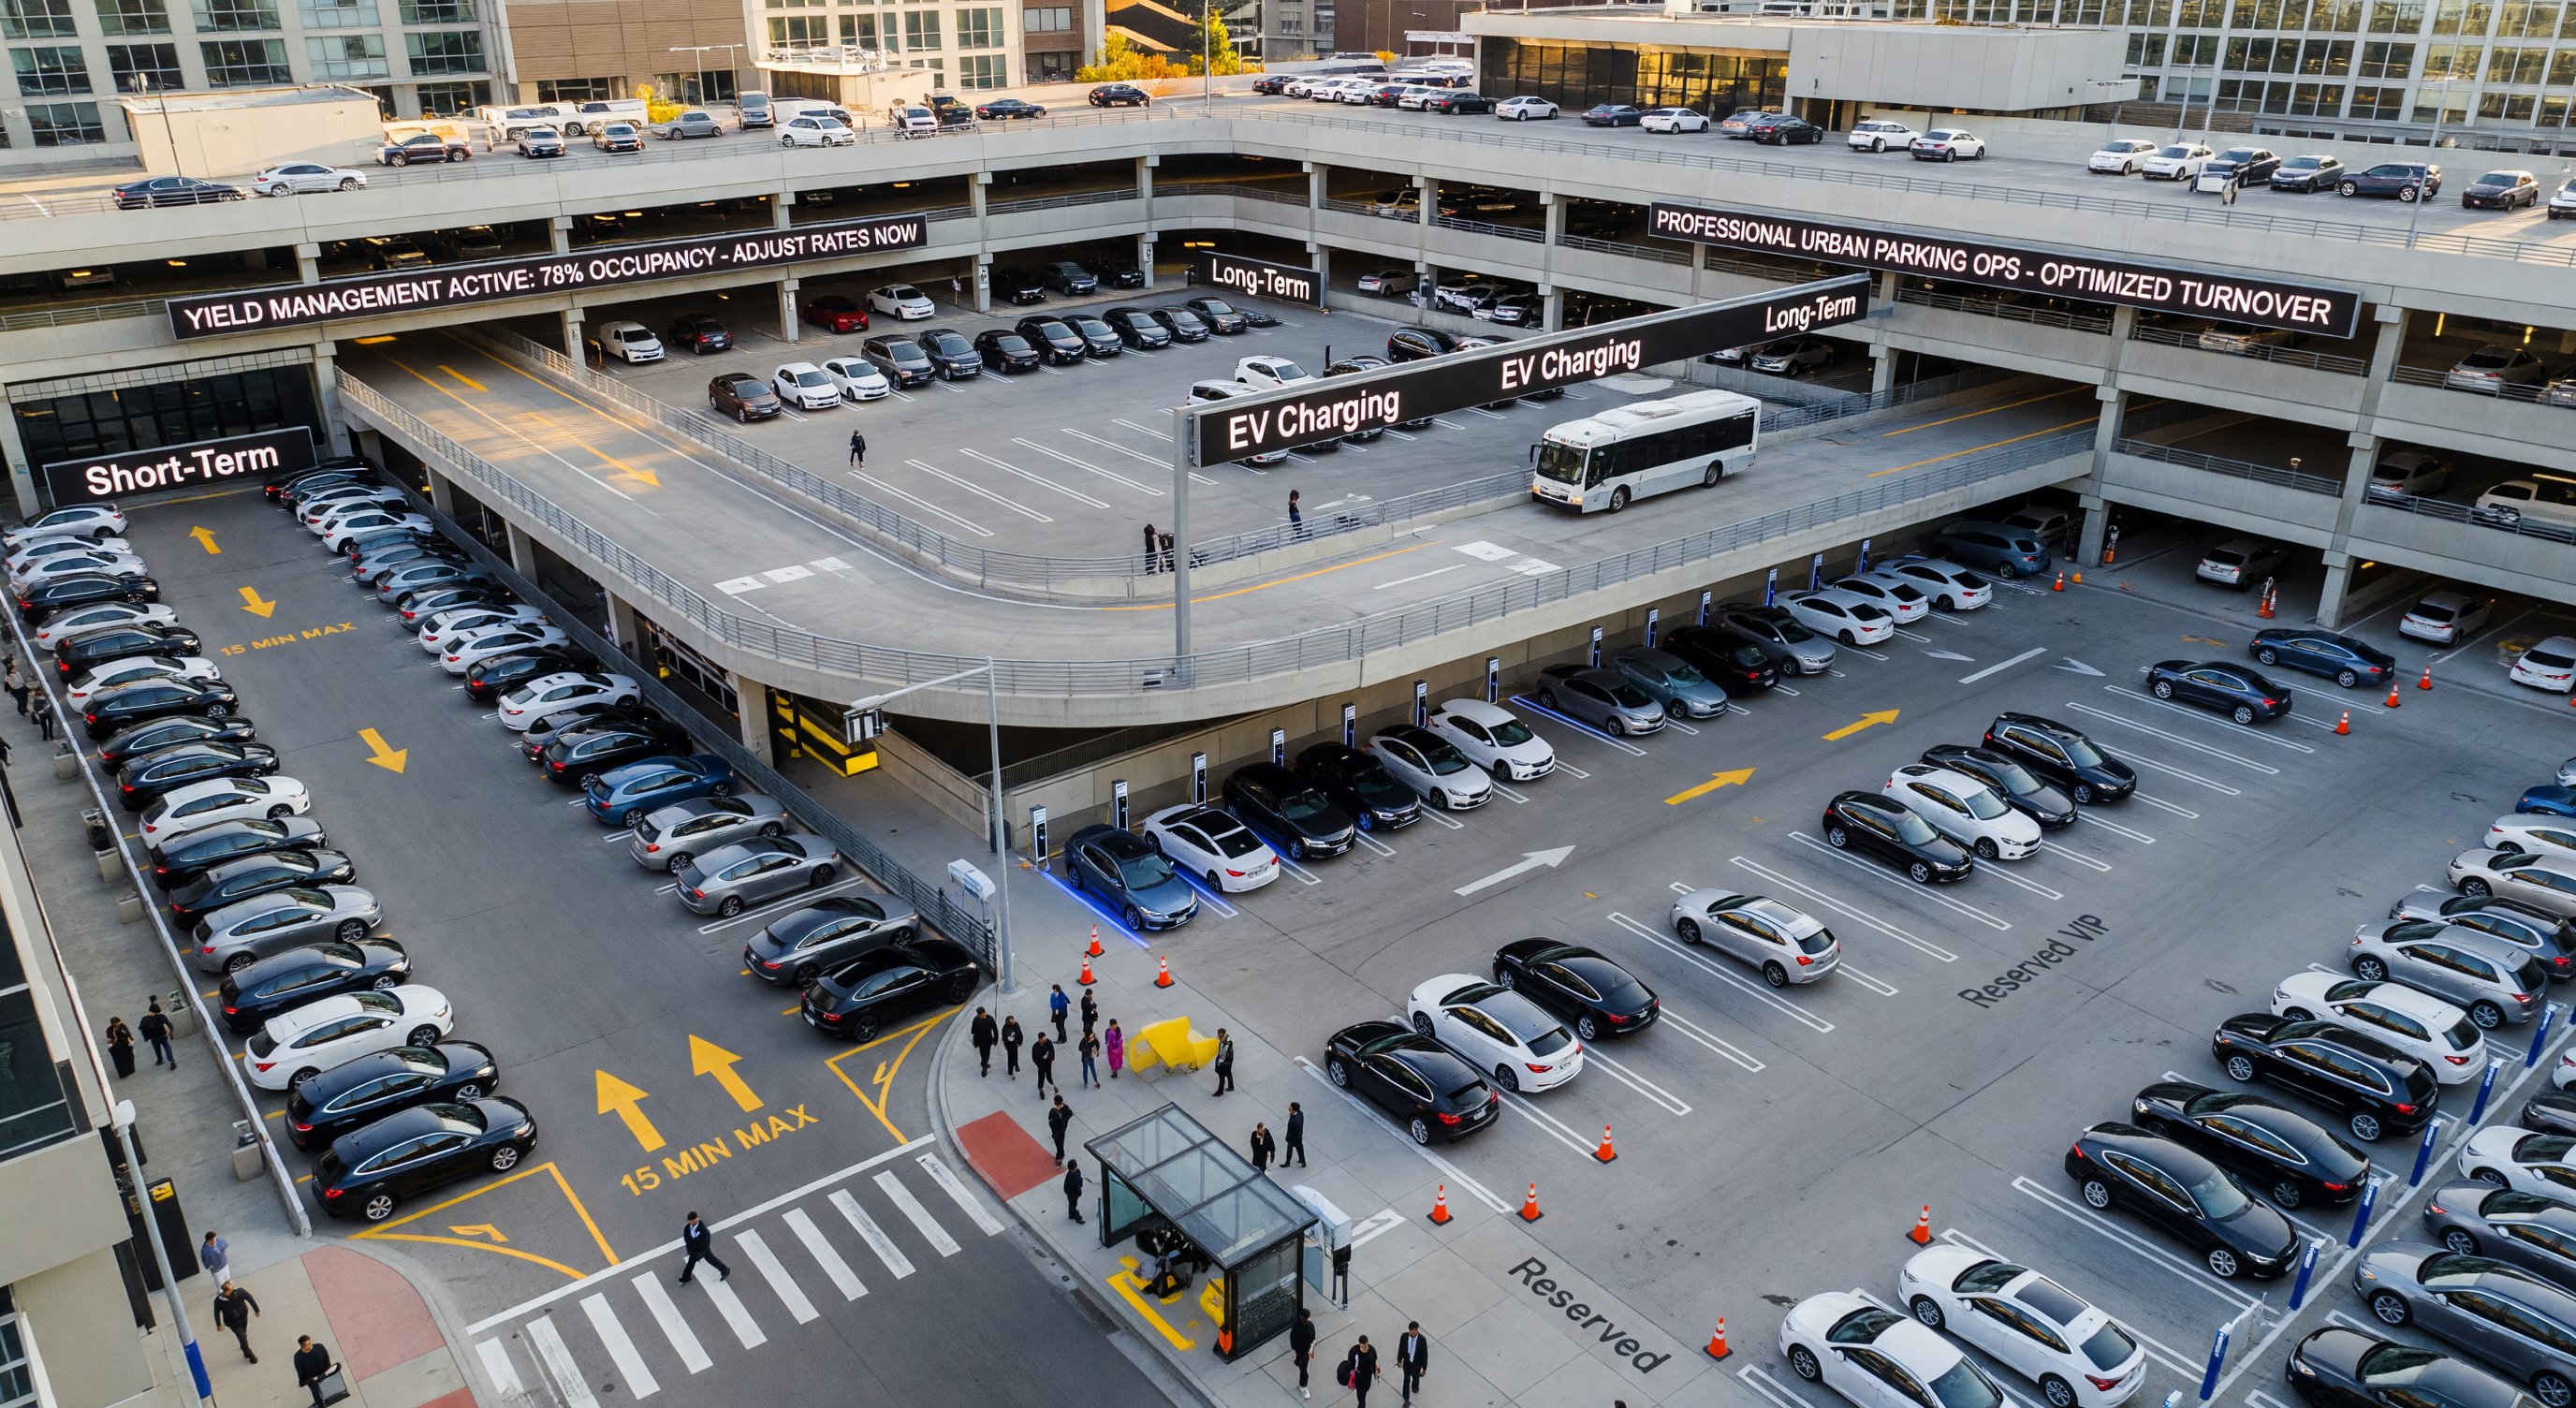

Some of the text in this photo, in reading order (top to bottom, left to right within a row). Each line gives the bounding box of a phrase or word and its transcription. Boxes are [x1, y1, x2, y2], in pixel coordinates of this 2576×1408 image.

[184, 301, 262, 330] YIELD
[269, 279, 442, 319] MANAGEMENT
[448, 269, 535, 298] ACTIVE:
[539, 262, 584, 286] 78%
[589, 246, 716, 280] OCCUPANCY
[733, 235, 806, 263] ADJUST
[811, 228, 870, 252] RATES
[874, 223, 918, 244] NOW
[1212, 258, 1310, 300] Long-Term
[1657, 210, 1796, 248] PROFESSIONAL
[1801, 229, 1870, 258] URBAN
[1874, 239, 1967, 272] PARKING
[1973, 253, 2020, 280] OPS
[2041, 261, 2173, 301] OPTIMIZED
[2179, 280, 2331, 326] TURNOVER
[1765, 297, 1856, 332] Long-Term
[1501, 339, 1642, 389] EV Charging
[1230, 389, 1400, 450] EV Charging
[85, 446, 279, 495] Short-Term
[220, 622, 358, 656] 15 MIN MAX
[1956, 914, 2110, 1008] Reserved VIP
[621, 1104, 820, 1196] 15 MIN MAX
[1507, 1256, 1673, 1374] Reserved
